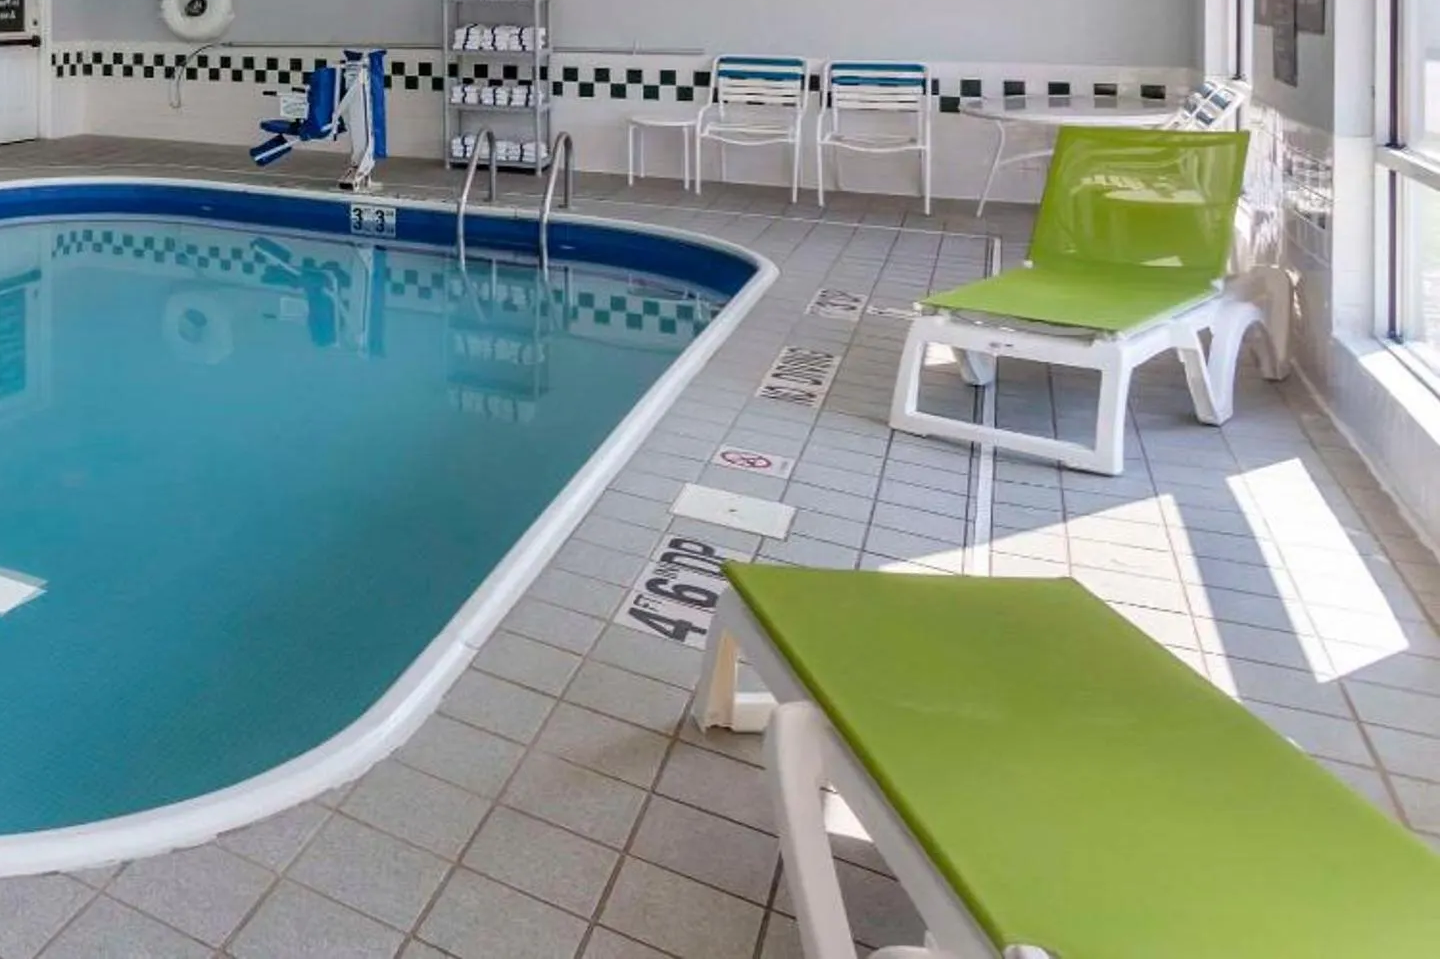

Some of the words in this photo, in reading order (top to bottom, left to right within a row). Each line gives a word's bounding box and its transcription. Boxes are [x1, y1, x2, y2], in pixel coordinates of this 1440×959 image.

[660, 538, 728, 578] DP
[645, 577, 719, 609] 6
[627, 607, 708, 643] 4
